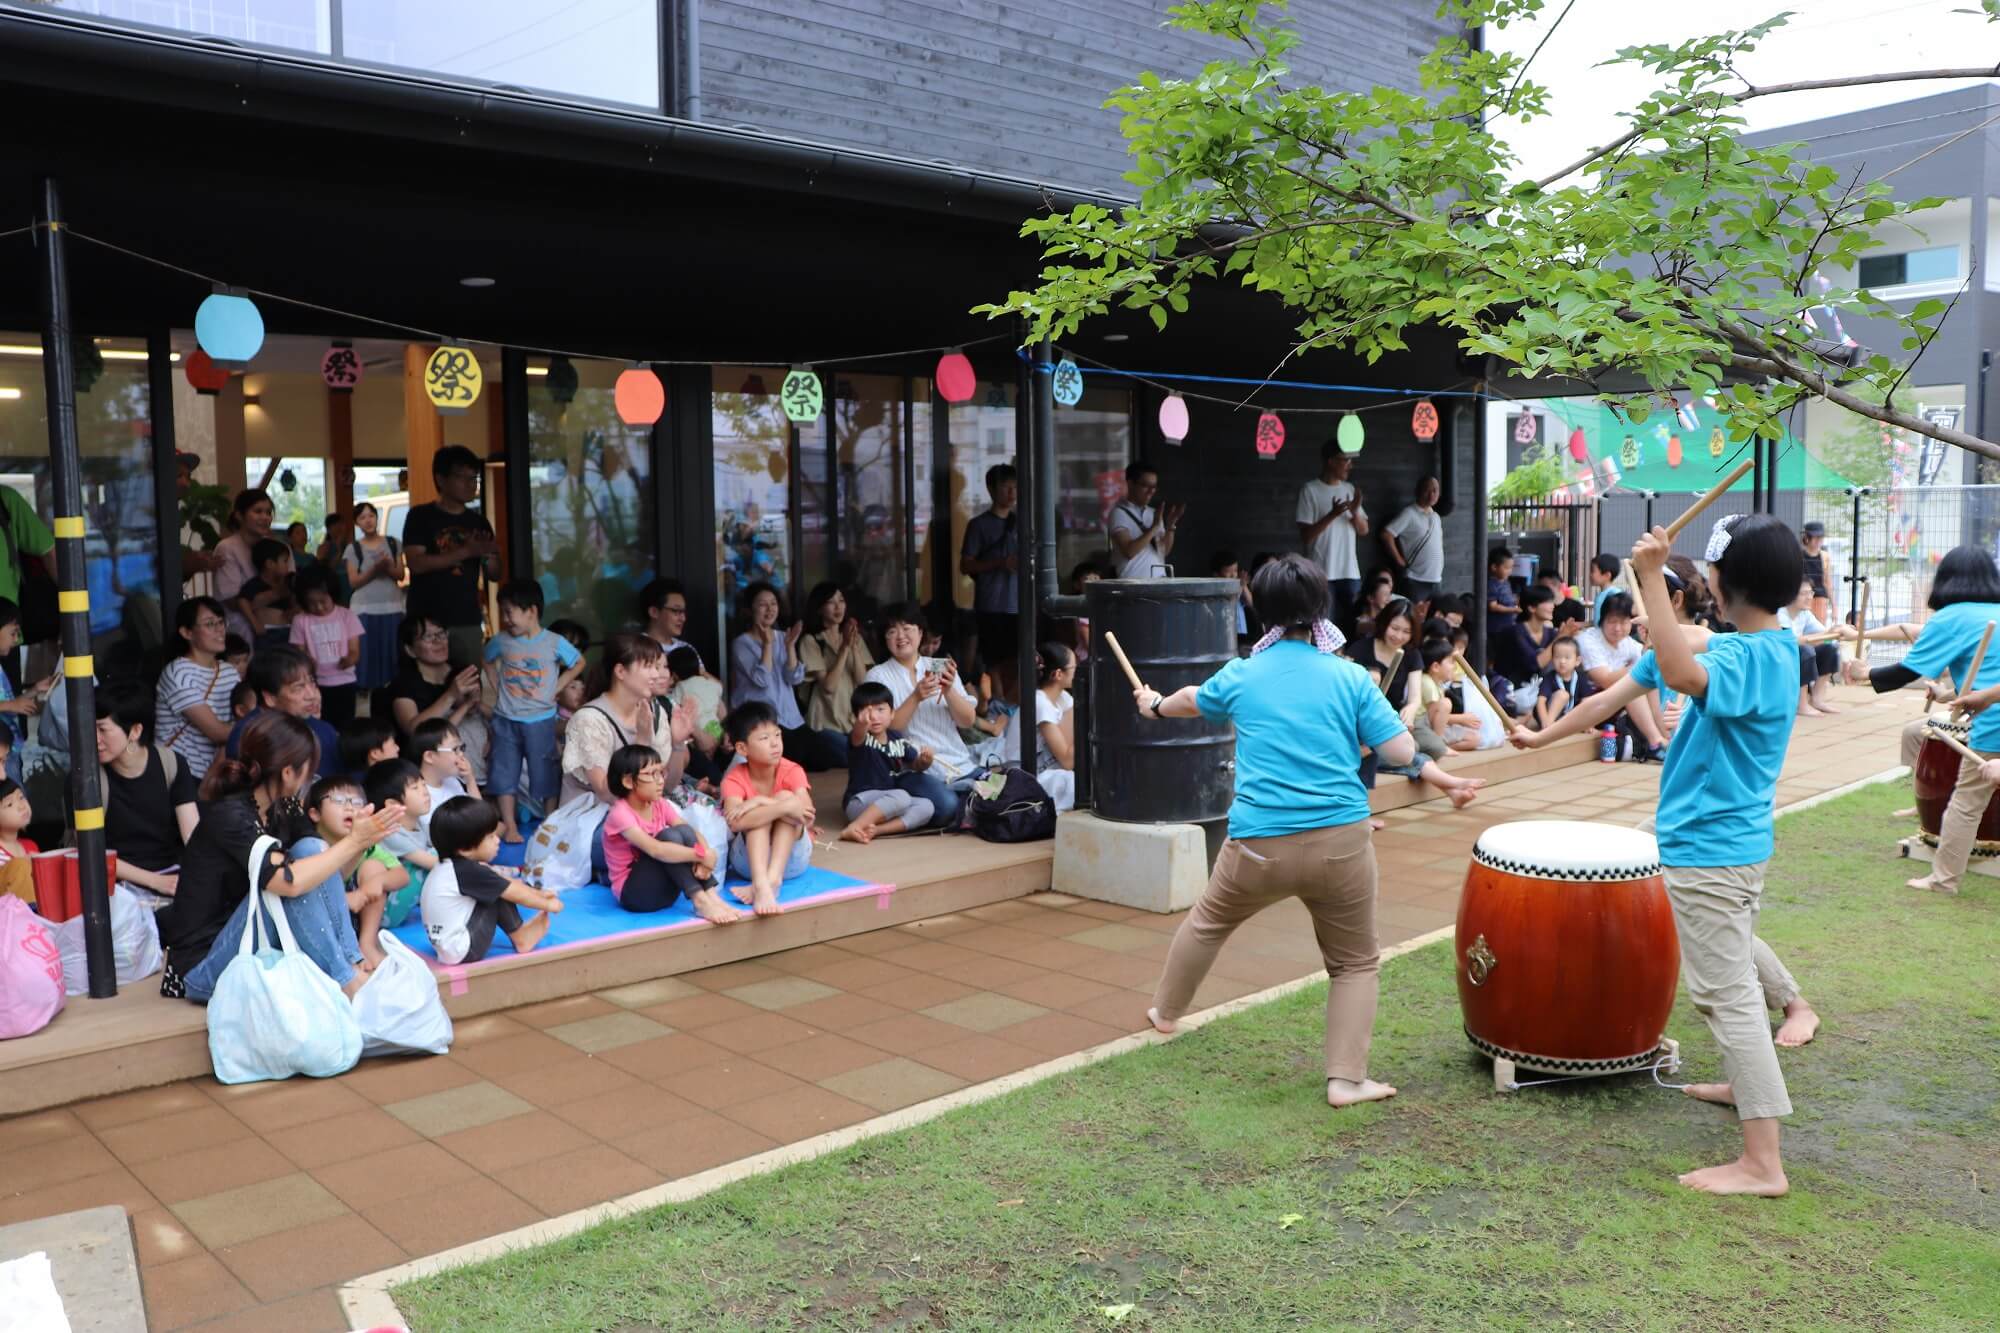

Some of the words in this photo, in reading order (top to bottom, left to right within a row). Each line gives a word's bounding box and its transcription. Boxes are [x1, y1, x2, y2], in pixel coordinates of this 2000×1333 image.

[325, 350, 357, 383] 祭
[427, 349, 477, 401] 祭
[1056, 362, 1079, 400] 祭
[784, 375, 818, 417] 祭
[1259, 418, 1283, 451] 祭
[1415, 406, 1435, 434] 祭
